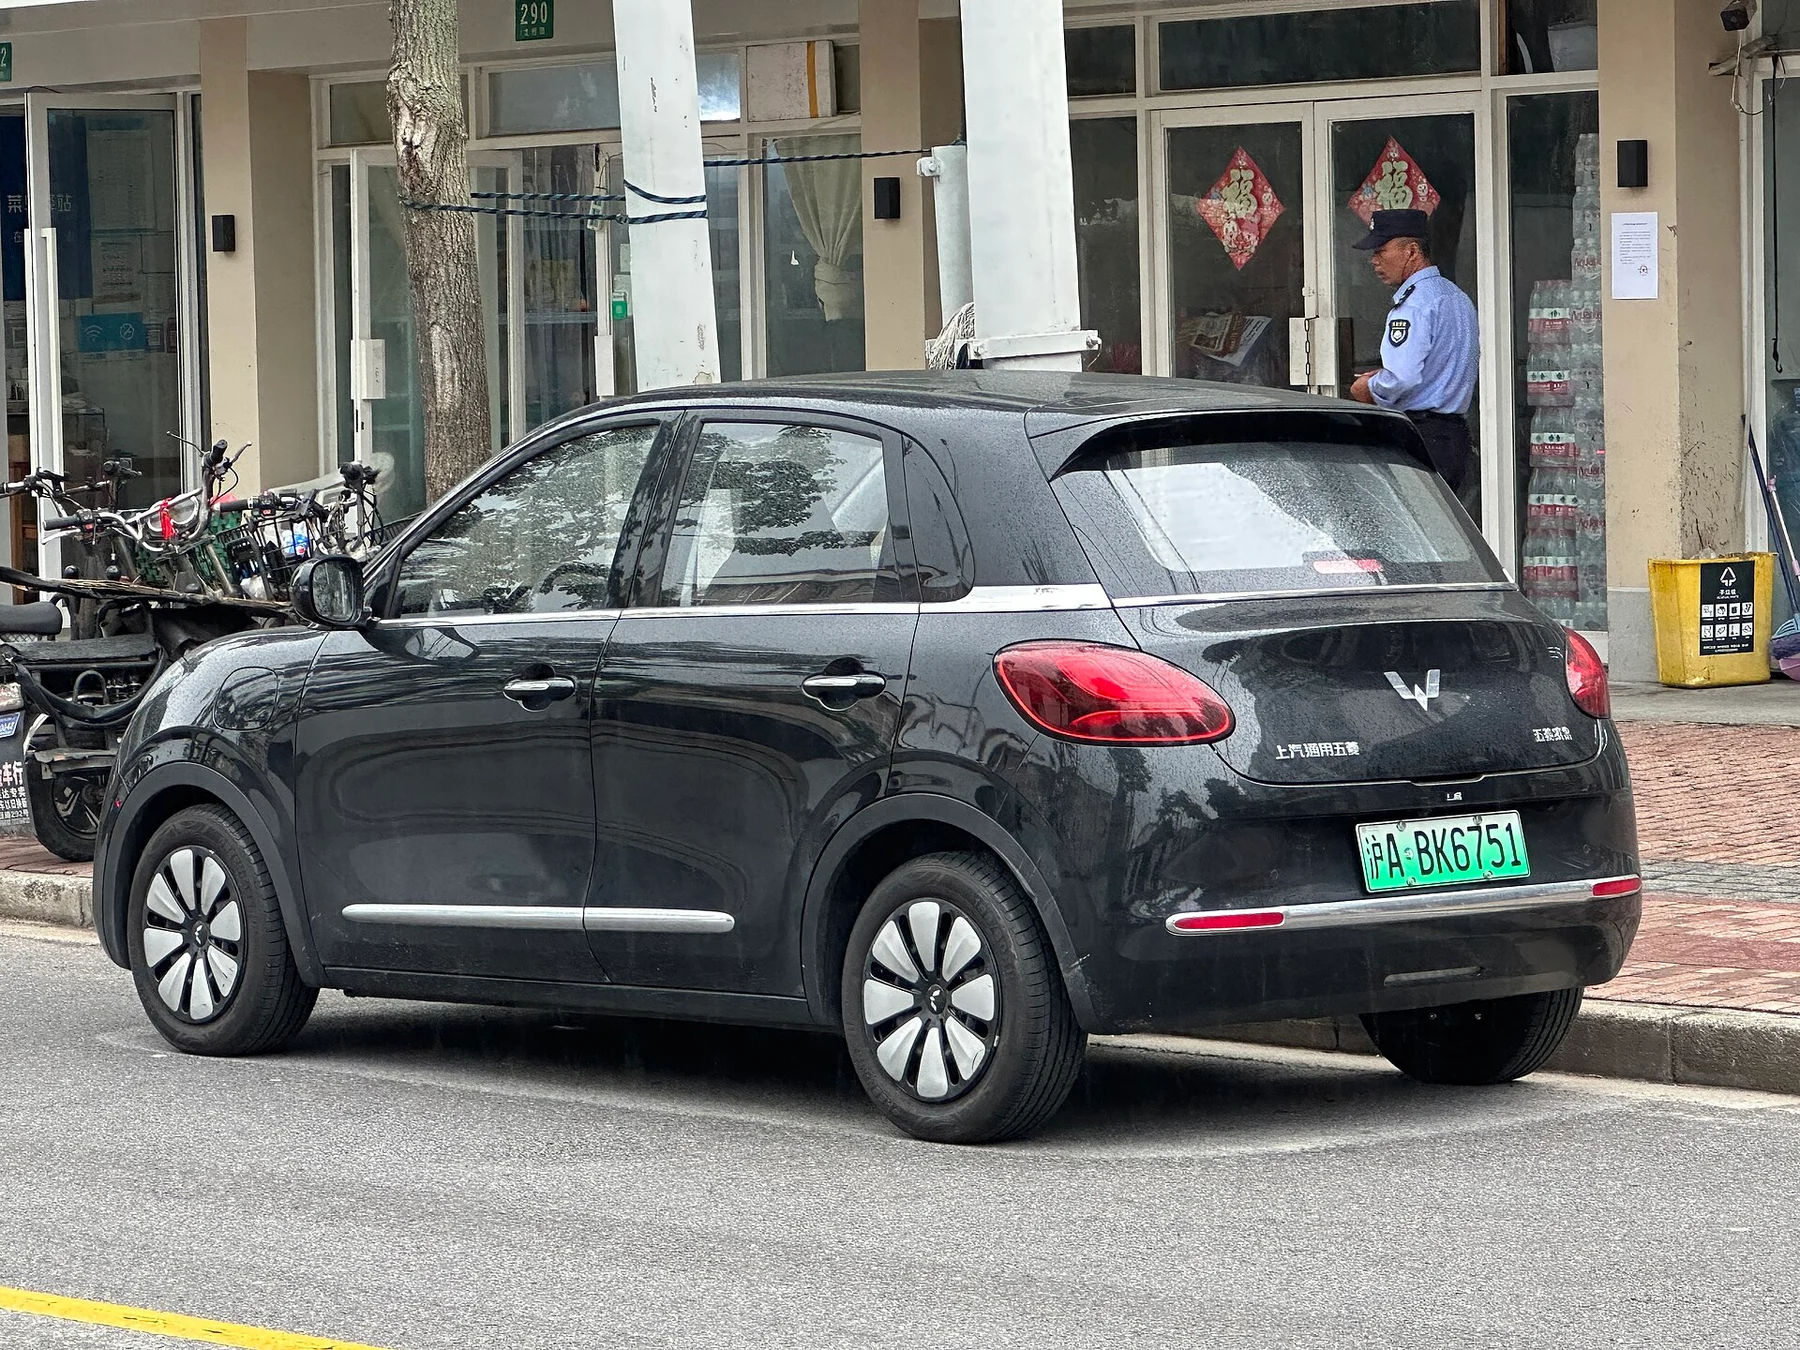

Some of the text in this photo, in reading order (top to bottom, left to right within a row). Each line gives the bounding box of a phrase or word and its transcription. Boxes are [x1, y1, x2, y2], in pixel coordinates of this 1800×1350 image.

[520, 1, 548, 25] 290
[1275, 741, 1360, 760] 上汽通用五菱
